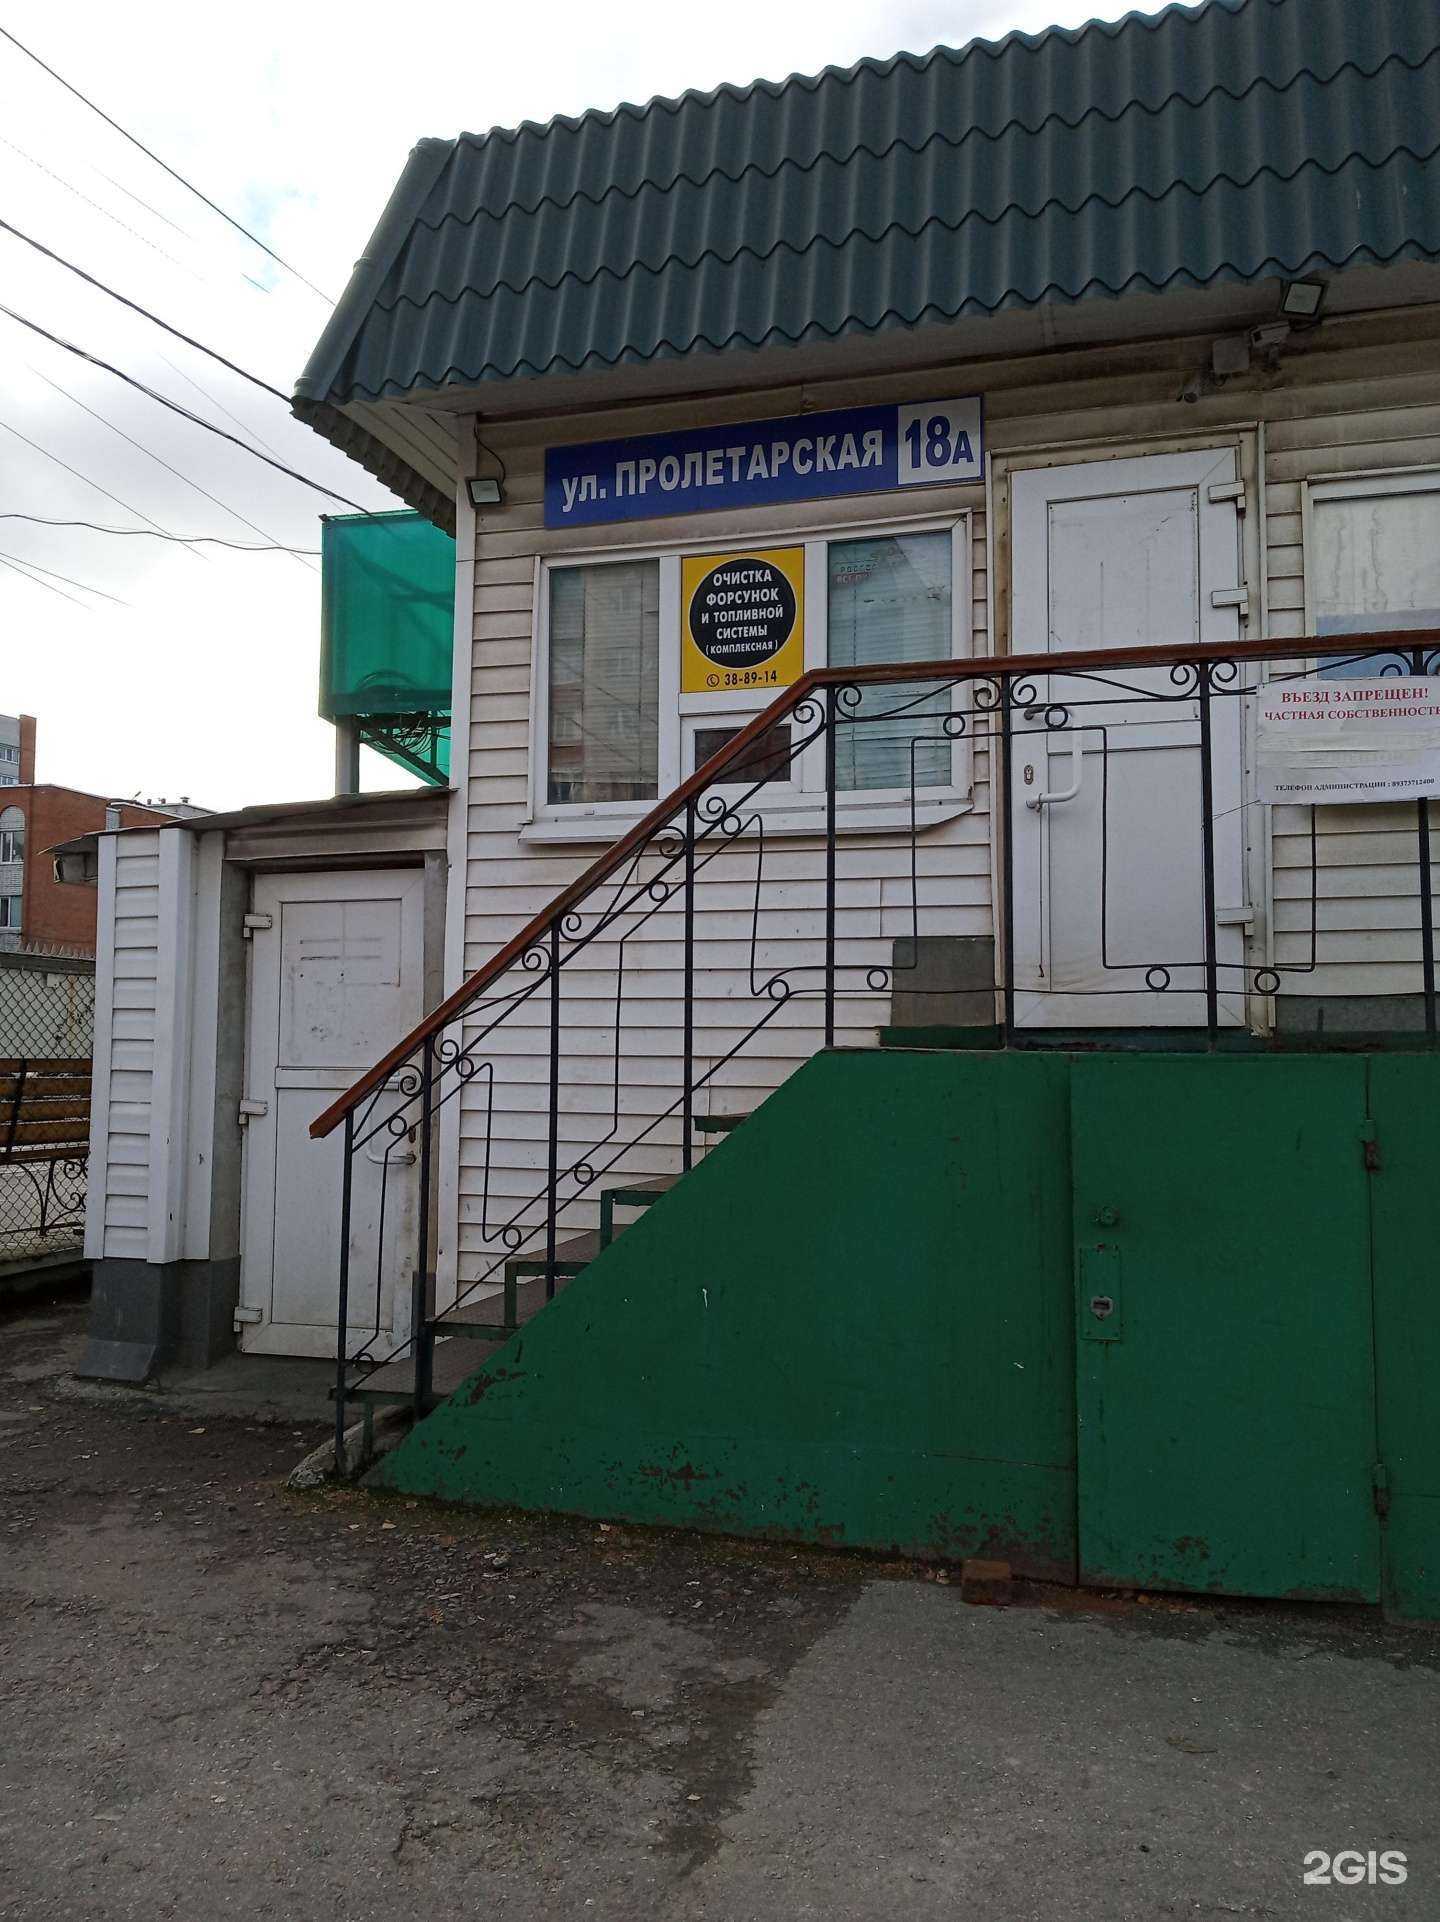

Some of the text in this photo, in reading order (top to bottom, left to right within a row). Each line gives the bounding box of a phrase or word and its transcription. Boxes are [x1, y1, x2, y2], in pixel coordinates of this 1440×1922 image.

[561, 415, 975, 513] ул. ПРОЛЕТАРСКАЯ 18А
[713, 569, 773, 586] ОЧИСТКА
[706, 588, 780, 606] ФОРСУНОК
[701, 605, 784, 624] И ТОПЛИВНОЙ
[716, 625, 768, 640] СИСТЕМЫ
[724, 670, 778, 686] 38-89-14
[1282, 687, 1429, 704] ВЪЕЗД ЗАПРЕЩЕН!
[1265, 709, 1325, 721] ЧАСТНАЯ
[1274, 783, 1312, 792] ТЕЛЕФОН
